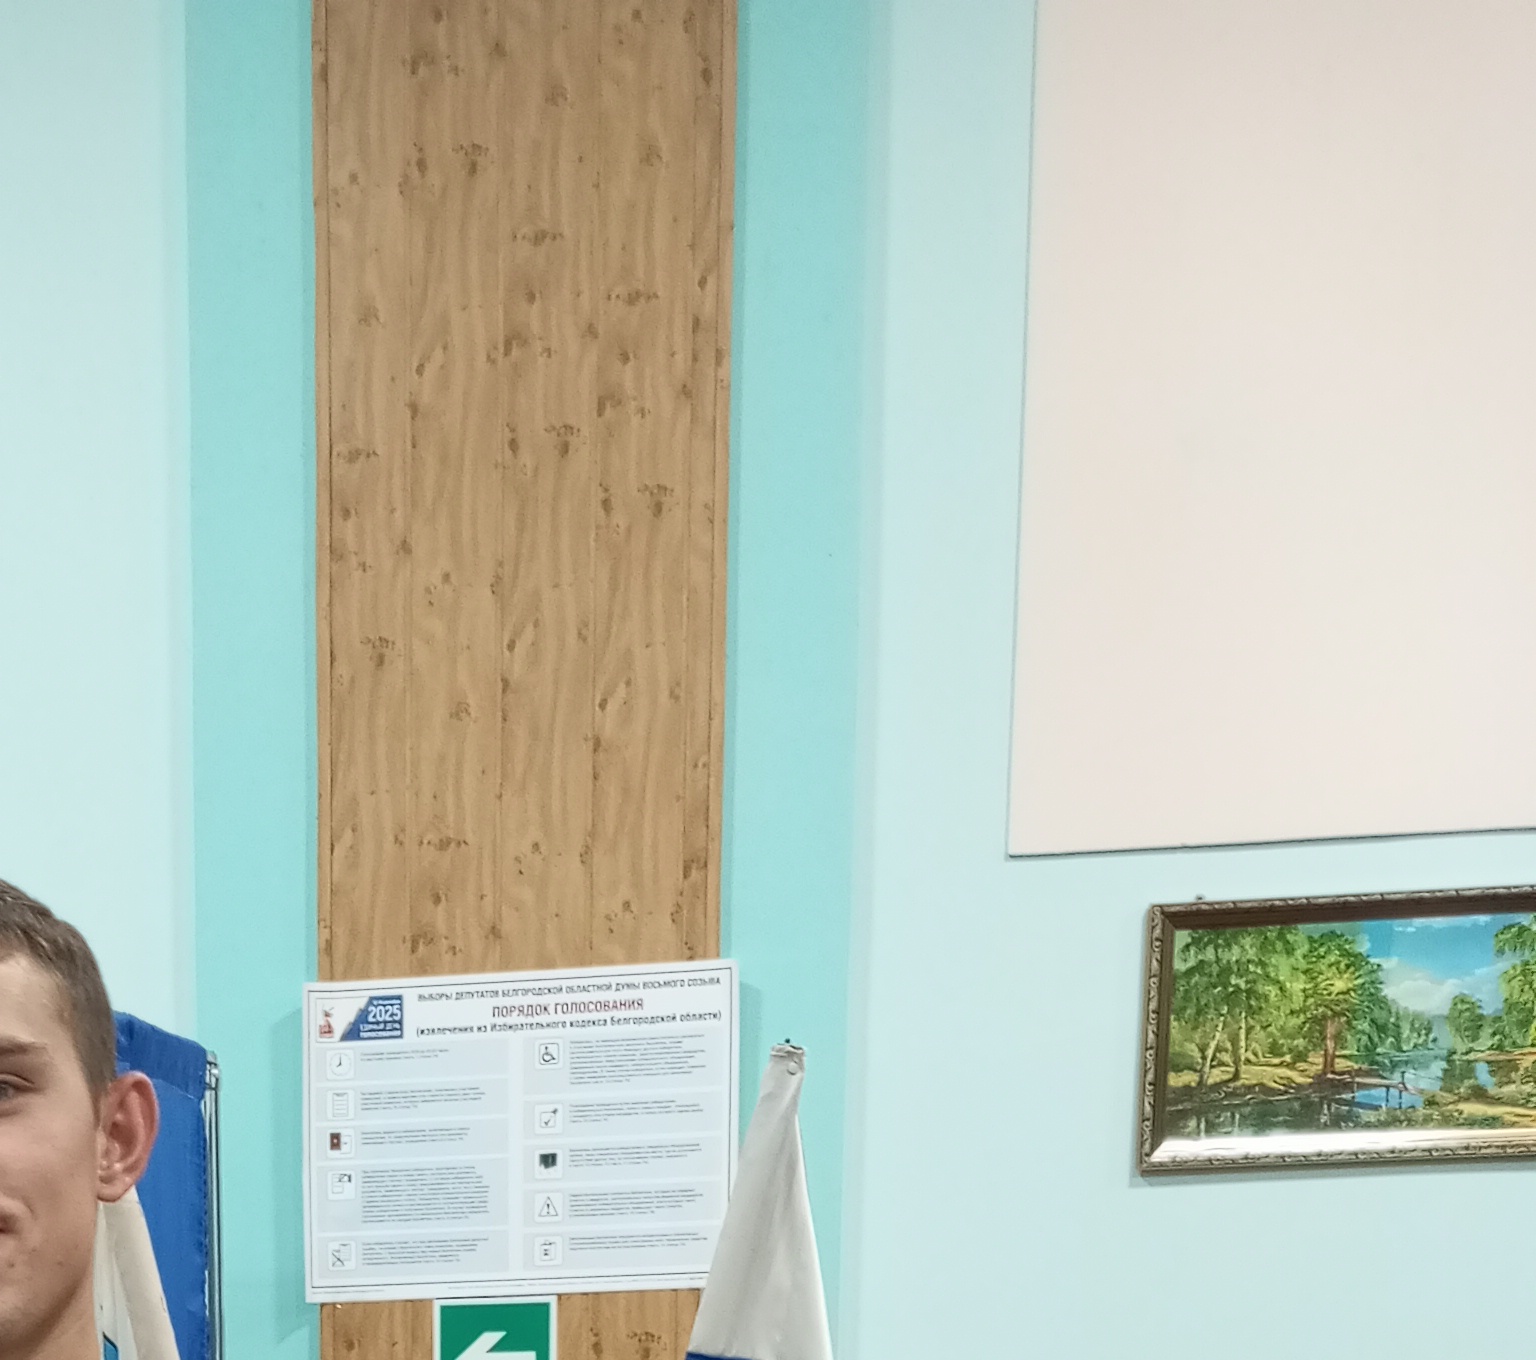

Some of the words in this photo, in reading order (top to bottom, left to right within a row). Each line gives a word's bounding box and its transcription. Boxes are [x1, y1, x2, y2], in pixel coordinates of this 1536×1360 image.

[455, 990, 499, 1000] ДЕПУТАТОВ
[502, 985, 563, 998] БЕЛГОРОДСКОЙ
[565, 982, 612, 994] ОБЛАСТНОЙ
[367, 1004, 401, 1022] 2025
[492, 1003, 550, 1018] ПОРЯДОК
[554, 998, 644, 1015] ГОЛОСОВАНИЯ
[490, 1021, 567, 1032] Избирательного
[569, 1019, 607, 1029] кодекса
[610, 1014, 677, 1026] Белгородской
[679, 1010, 722, 1022] области)
